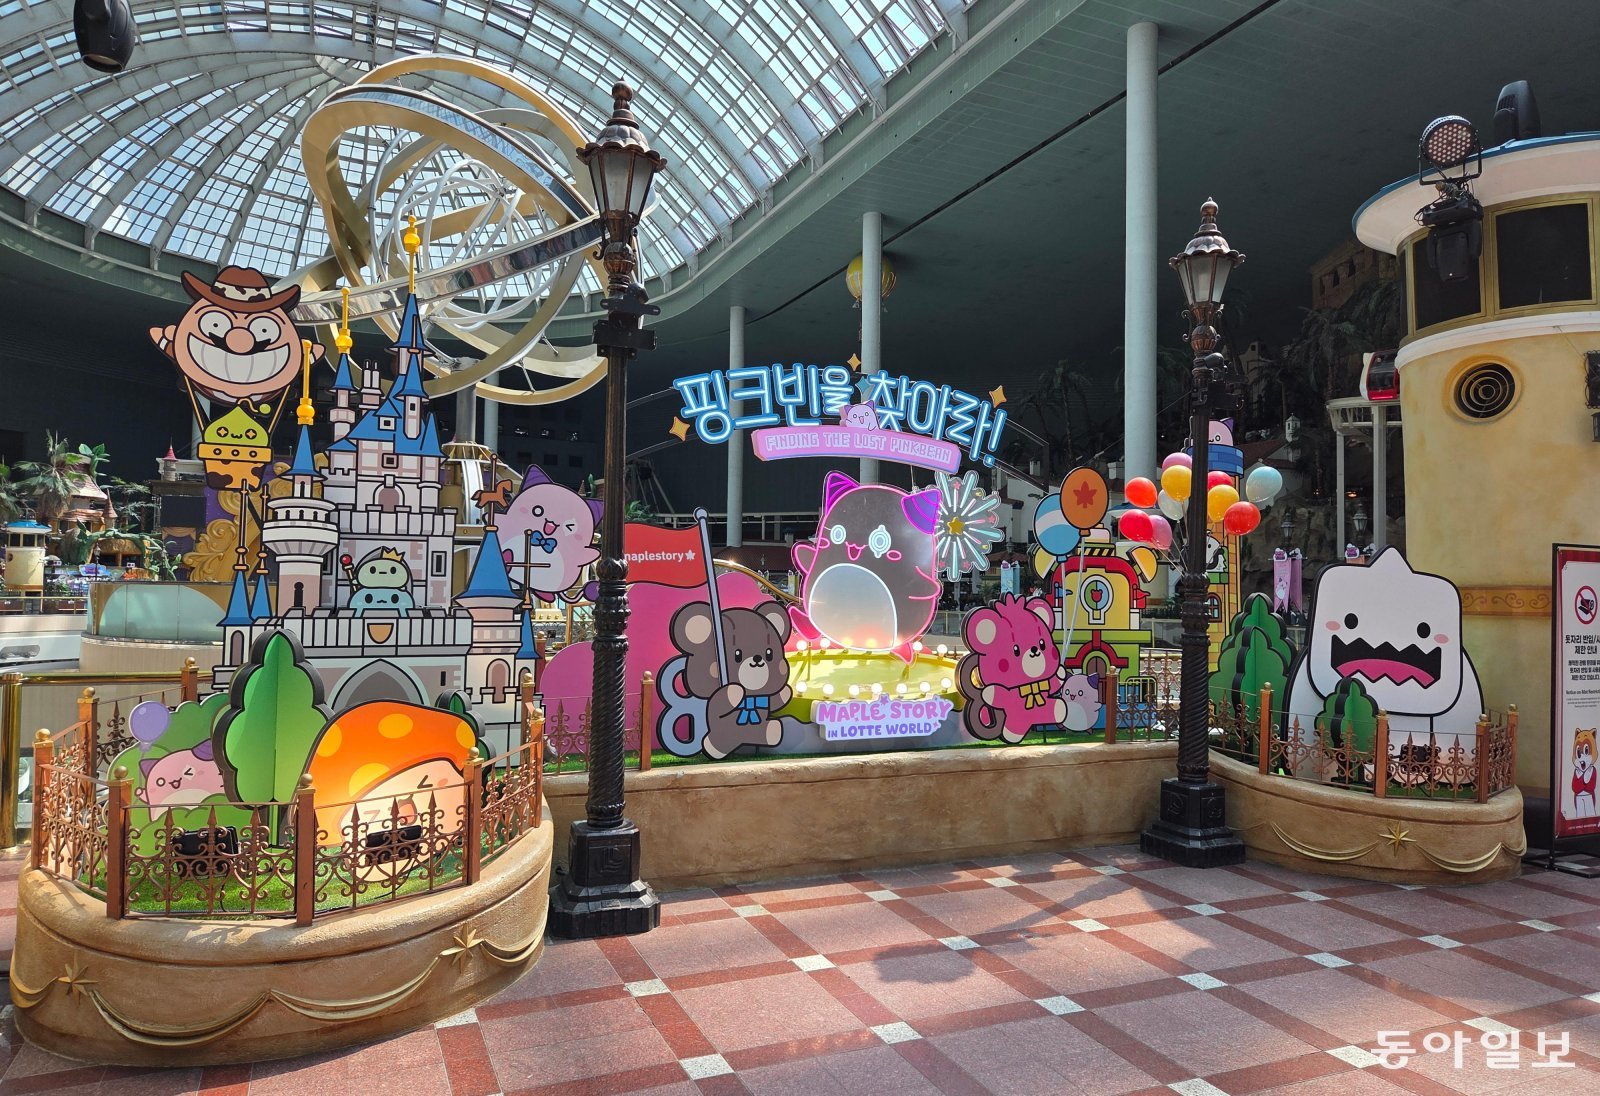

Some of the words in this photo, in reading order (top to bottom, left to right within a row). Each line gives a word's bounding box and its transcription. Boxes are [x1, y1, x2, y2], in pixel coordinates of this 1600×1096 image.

[673, 363, 853, 444] 핑크빈을
[867, 370, 1007, 467] 찾아라!
[766, 433, 819, 451] FINDING
[822, 432, 851, 447] THE
[854, 433, 886, 450] LOST
[890, 437, 951, 464] PINKBEAN
[1575, 646, 1586, 654] 제한
[1587, 646, 1597, 654] 안내
[818, 703, 886, 722] MAPLE
[890, 701, 952, 721] STORY
[828, 730, 838, 738] IN
[841, 724, 882, 737] LOTTE
[886, 723, 932, 735] WORLD
